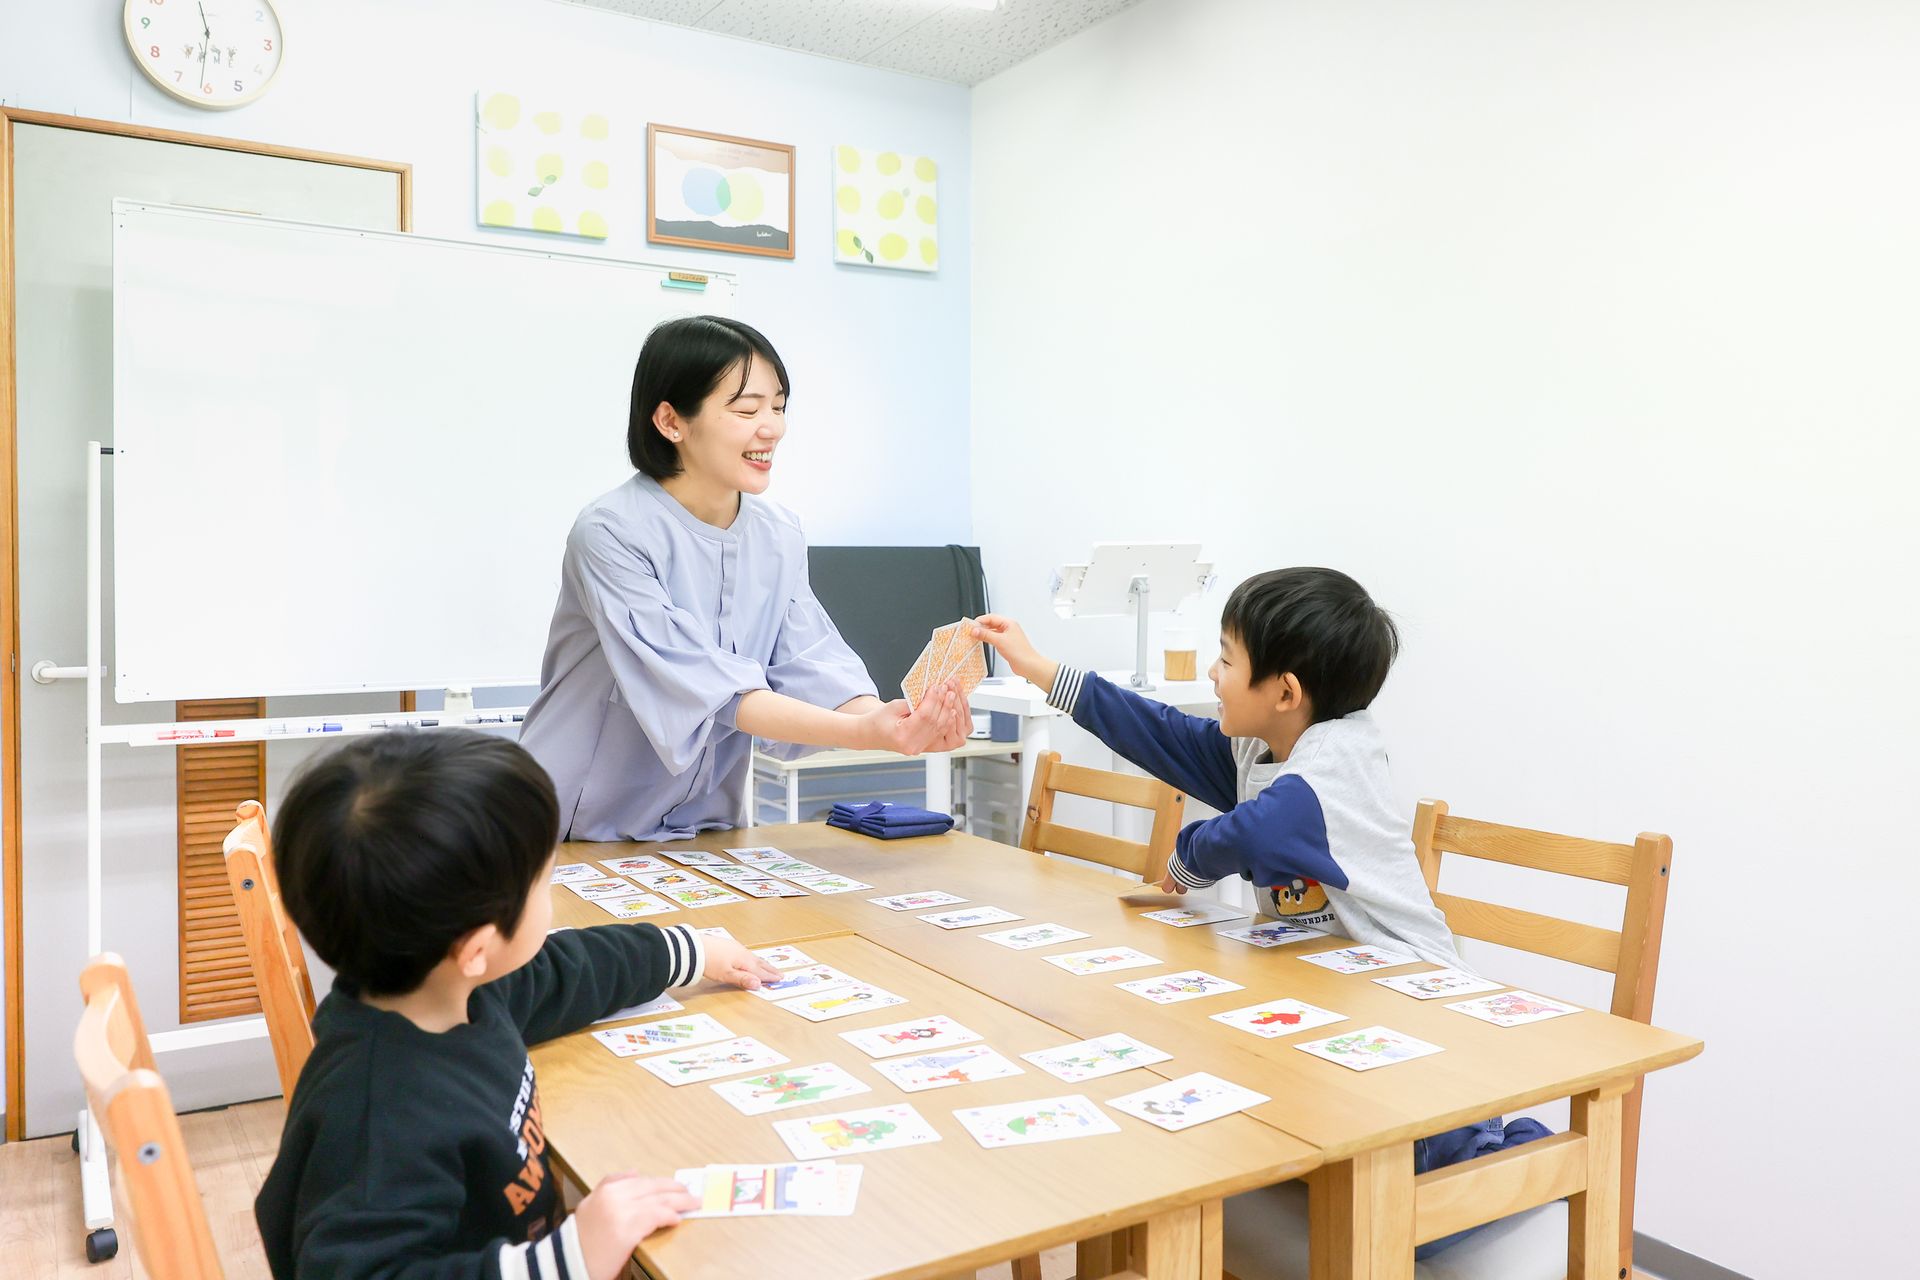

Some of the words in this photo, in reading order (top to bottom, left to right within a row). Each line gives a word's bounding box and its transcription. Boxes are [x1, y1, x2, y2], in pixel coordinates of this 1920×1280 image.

[255, 10, 264, 22] 2
[141, 17, 151, 29] 9
[263, 39, 273, 51] 3
[150, 46, 160, 58] 8
[174, 71, 183, 82] 7
[203, 83, 213, 94] 6
[234, 80, 243, 92] 5
